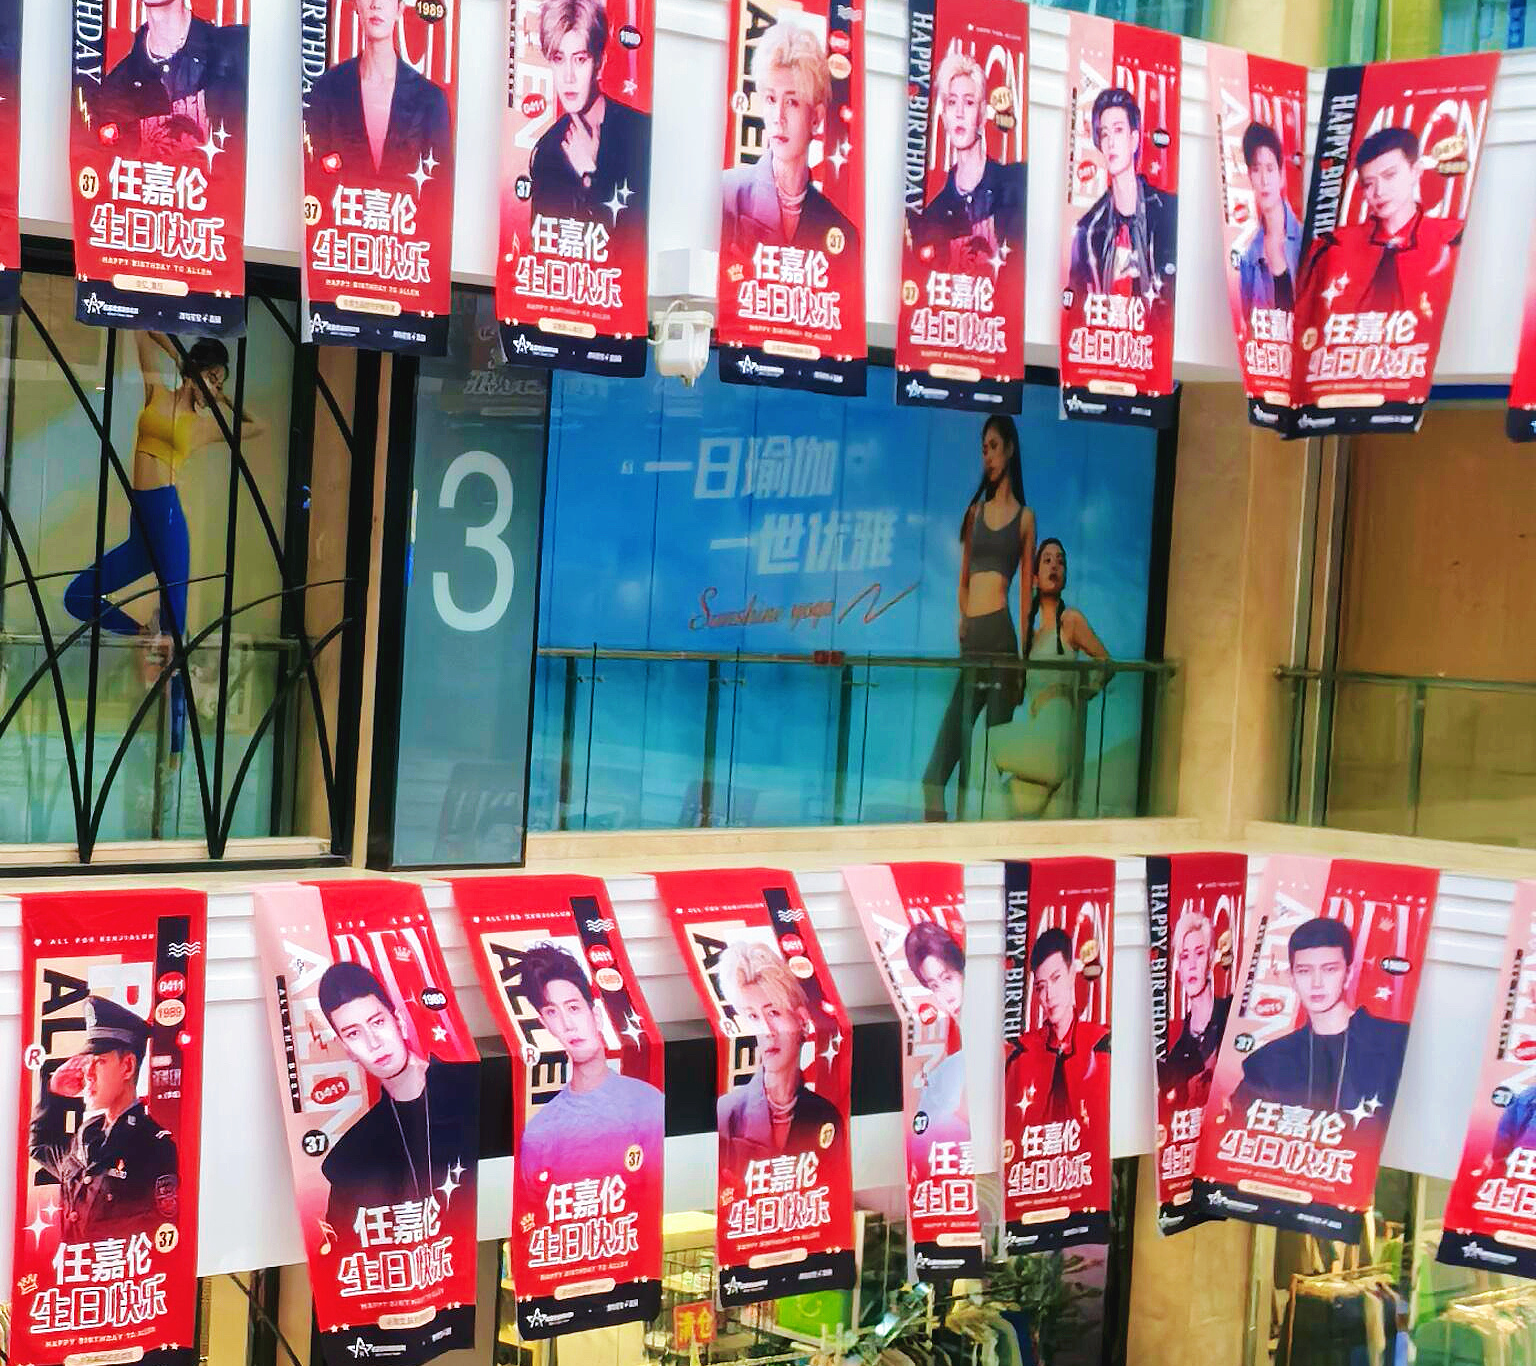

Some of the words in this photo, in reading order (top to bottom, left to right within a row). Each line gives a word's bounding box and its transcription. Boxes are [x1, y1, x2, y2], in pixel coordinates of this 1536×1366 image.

[416, 1, 444, 20] 1989
[81, 172, 97, 194] 37
[108, 156, 209, 210] 任嘉伦
[89, 201, 228, 262] 生日快乐
[303, 200, 318, 220] 37
[331, 185, 417, 233] 任嘉伦
[312, 229, 431, 283] 生日快乐
[531, 213, 609, 262] 任嘉伦
[514, 258, 624, 309] 生日快乐
[752, 242, 829, 288] 任嘉伦
[737, 284, 842, 330] 生日快乐
[925, 271, 994, 314] 任嘉伦
[1083, 294, 1145, 331] 任嘉伦
[910, 309, 1007, 354] 生日快乐
[1069, 329, 1154, 371] 生日快乐
[1322, 310, 1417, 345] 任嘉伦
[1305, 342, 1428, 380] 生日快乐
[643, 435, 840, 500] 一日瑜伽
[433, 450, 515, 633] 3
[159, 978, 184, 993] 0411
[304, 1133, 325, 1153] 37
[1021, 1121, 1081, 1159] 任嘉伦
[1246, 1098, 1345, 1144] 任嘉伦
[626, 1149, 642, 1166] 37
[744, 1153, 818, 1197] 任嘉伦
[1007, 1154, 1093, 1199] 生日快乐
[1215, 1129, 1358, 1186] 生日快乐
[352, 1195, 442, 1249] 任嘉伦
[544, 1175, 627, 1225] 任嘉伦
[726, 1185, 831, 1240] 生日快乐
[52, 1232, 152, 1286] 任嘉伦
[157, 1230, 175, 1248] 37
[527, 1211, 640, 1269] 生日快乐
[337, 1235, 454, 1299] 生日快乐
[29, 1275, 168, 1336] 生日快乐
